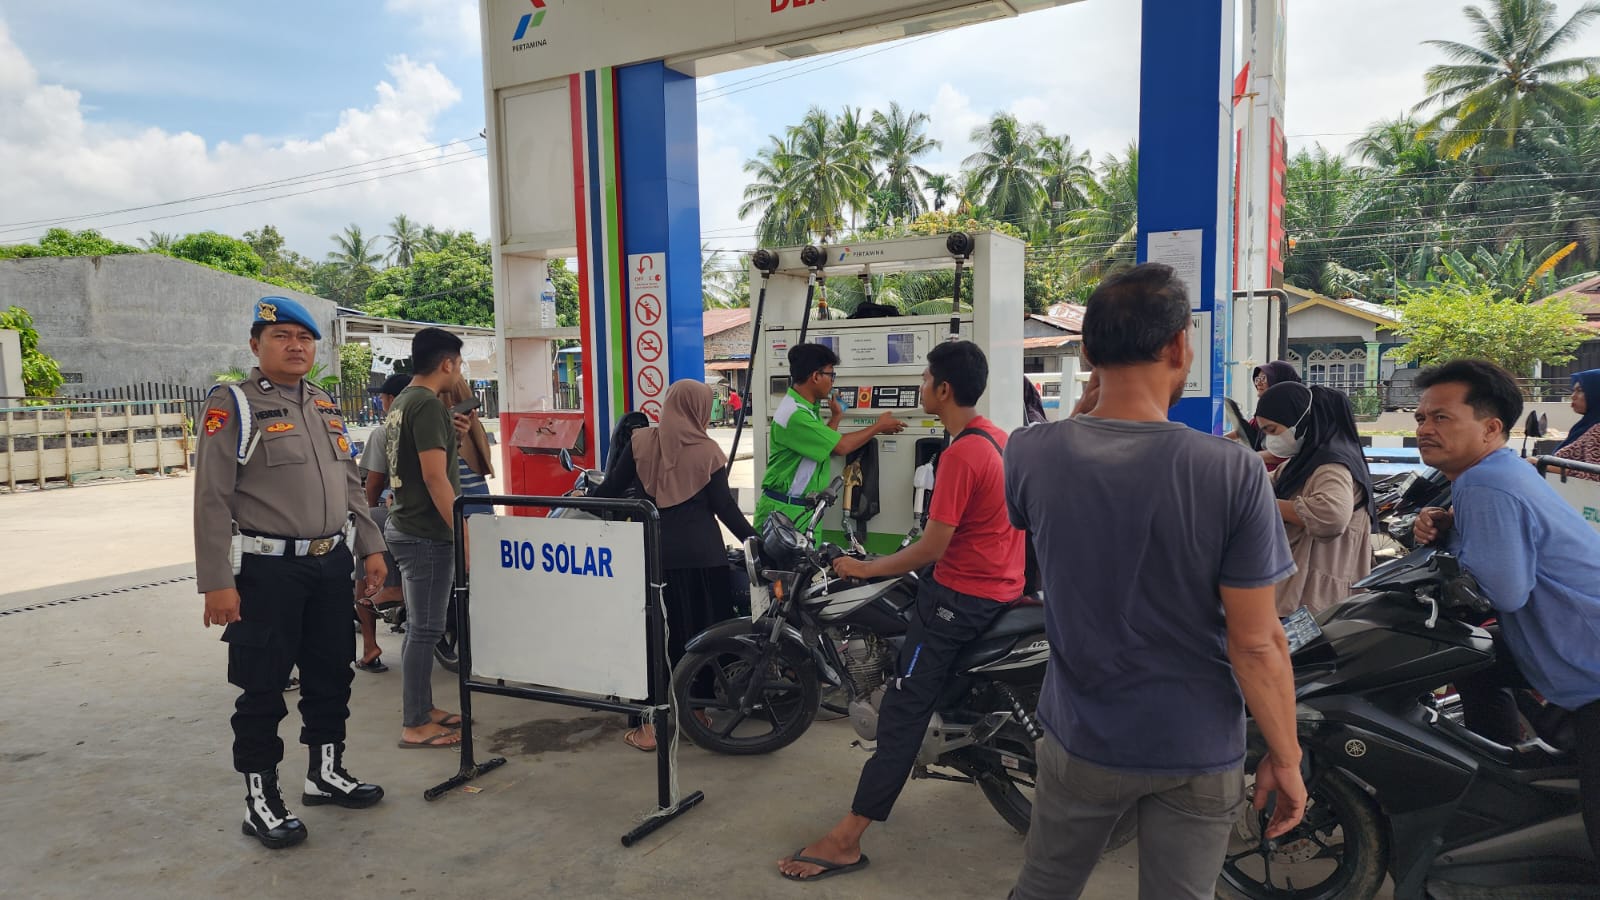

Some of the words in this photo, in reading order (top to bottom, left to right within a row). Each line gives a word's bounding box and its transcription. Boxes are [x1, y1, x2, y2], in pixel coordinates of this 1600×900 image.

[512, 40, 547, 52] PERTAMINA
[500, 539, 535, 571] BIO
[541, 543, 614, 578] SOLAR
